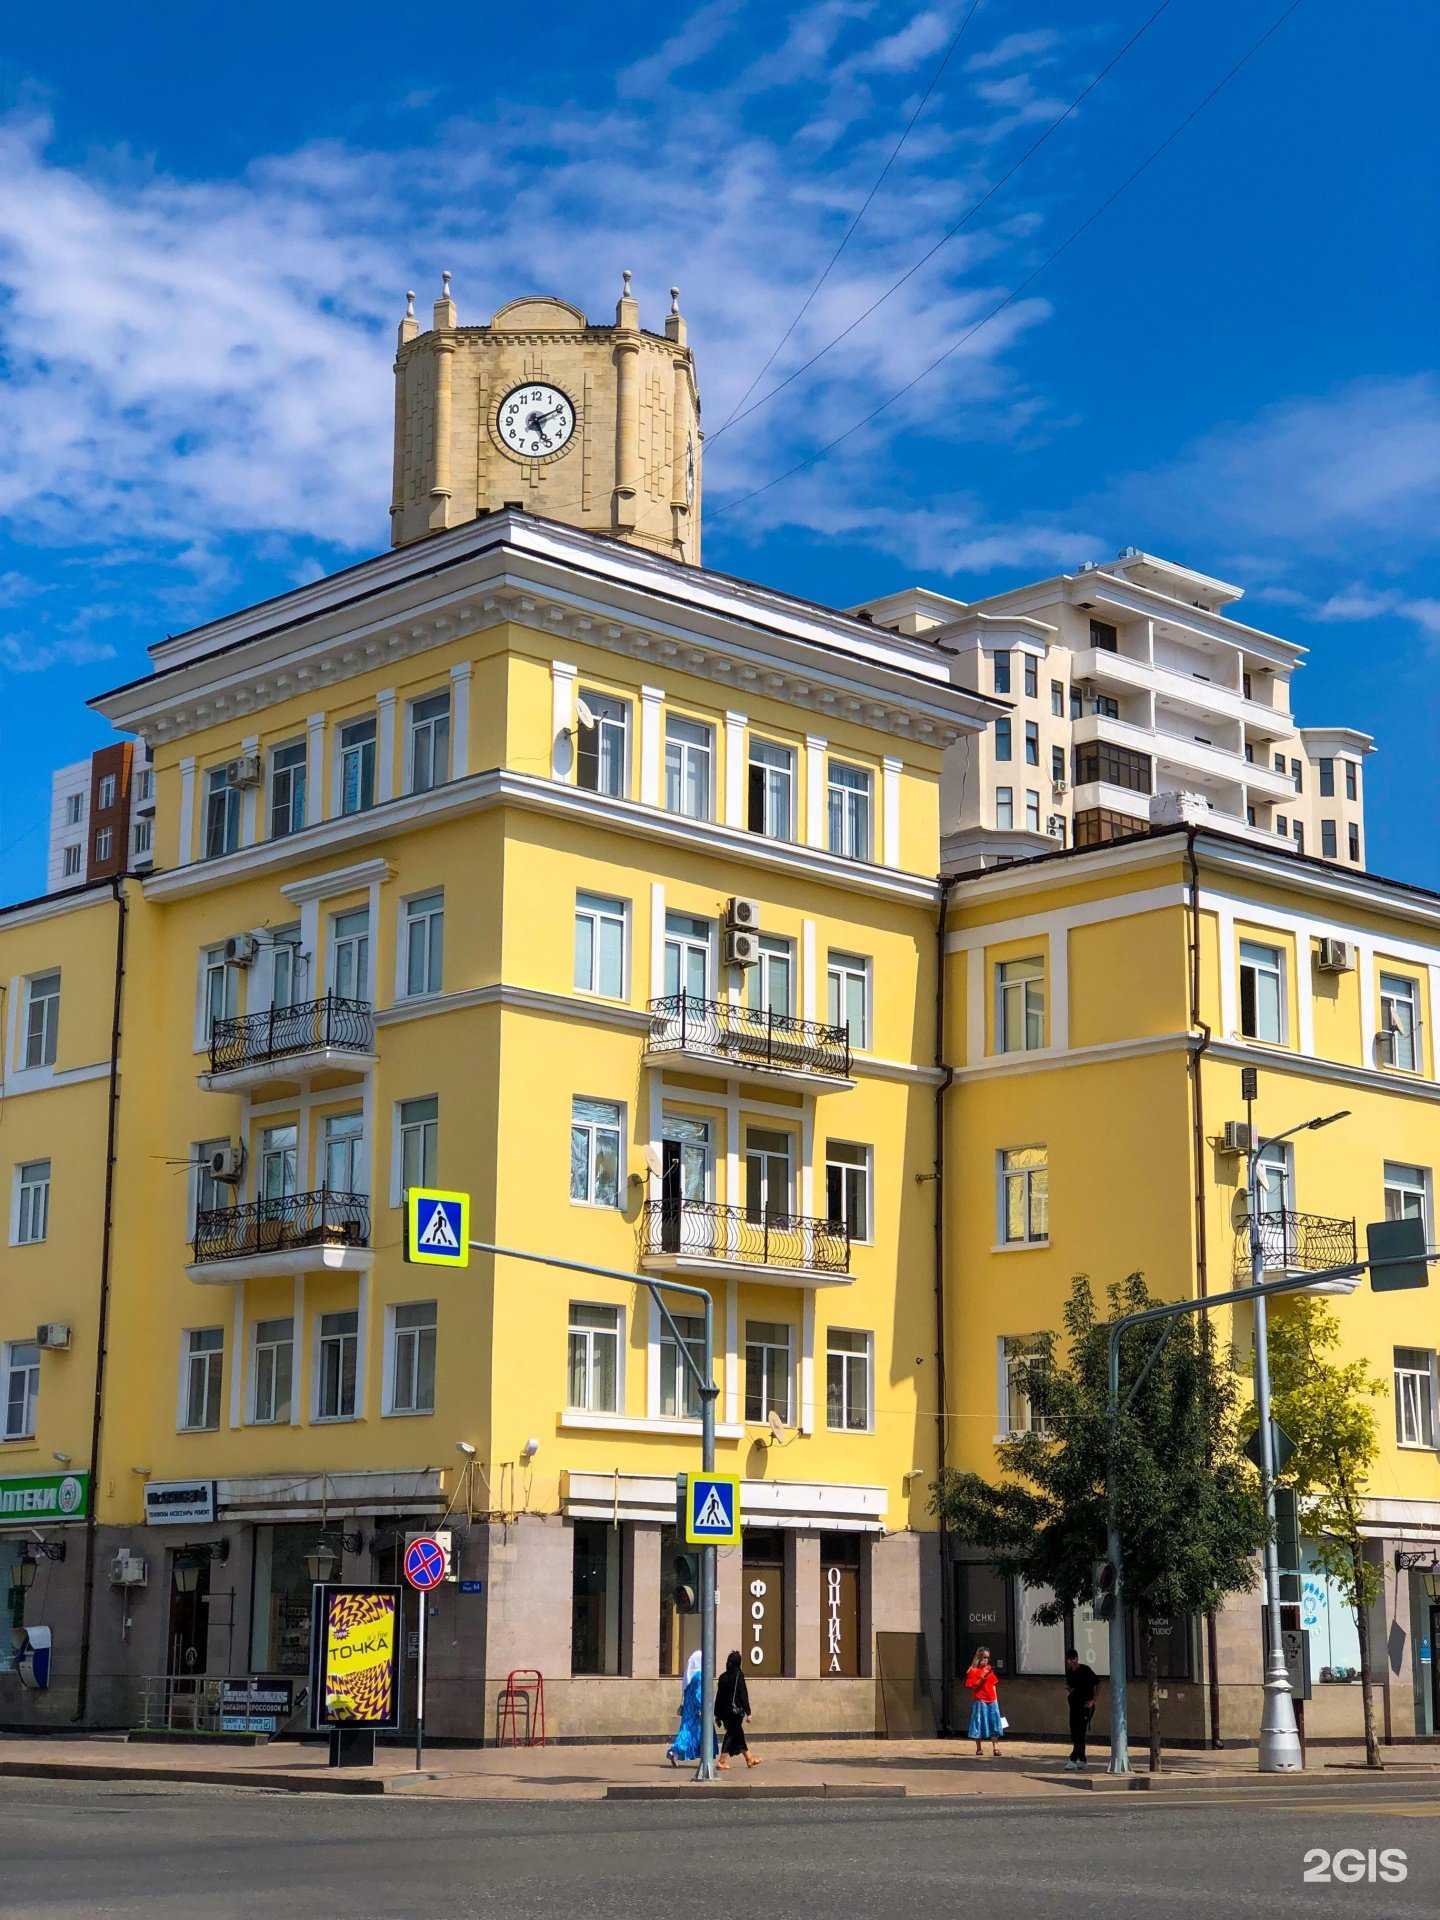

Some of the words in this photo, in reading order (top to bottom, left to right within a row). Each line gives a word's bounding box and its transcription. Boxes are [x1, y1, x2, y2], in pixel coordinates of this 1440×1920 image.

[519, 395, 528, 405] 11
[531, 391, 542, 401] 12
[547, 395, 552, 405] 1
[508, 404, 519, 414] 10
[505, 416, 514, 426] 9
[559, 416, 567, 426] 3
[509, 429, 517, 439] 8
[555, 429, 563, 439] 4
[518, 438, 525, 448] 7
[531, 441, 540, 452] 6
[544, 438, 553, 448] 5
[750, 1579, 767, 1665] ФОТО
[827, 1567, 841, 1671] ОПТИКА
[329, 1638, 389, 1661] ТОЧКА
